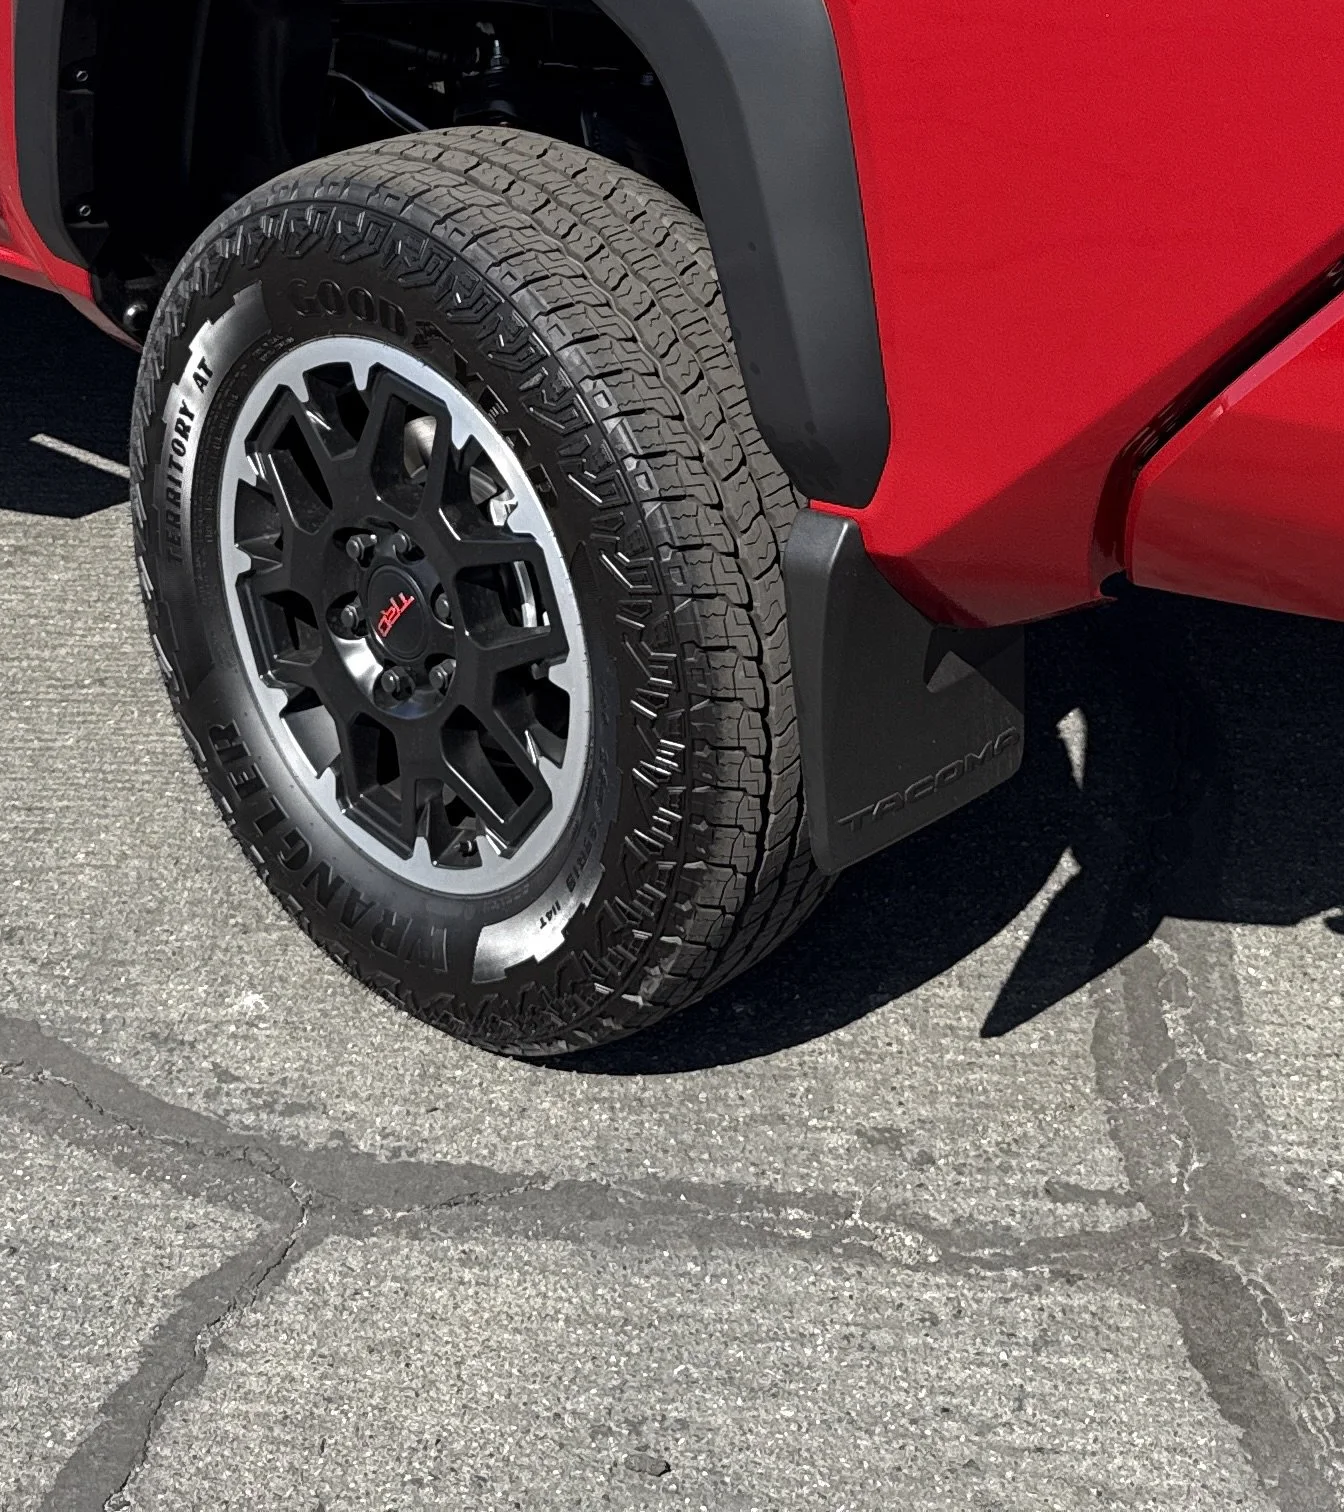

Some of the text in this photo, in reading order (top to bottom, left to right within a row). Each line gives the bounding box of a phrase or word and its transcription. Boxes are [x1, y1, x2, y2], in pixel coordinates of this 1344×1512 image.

[166, 356, 215, 566] TERRITORY AT
[377, 592, 415, 638] TRD
[208, 719, 449, 974] WRANGLER
[837, 727, 1020, 832] TACOMA
